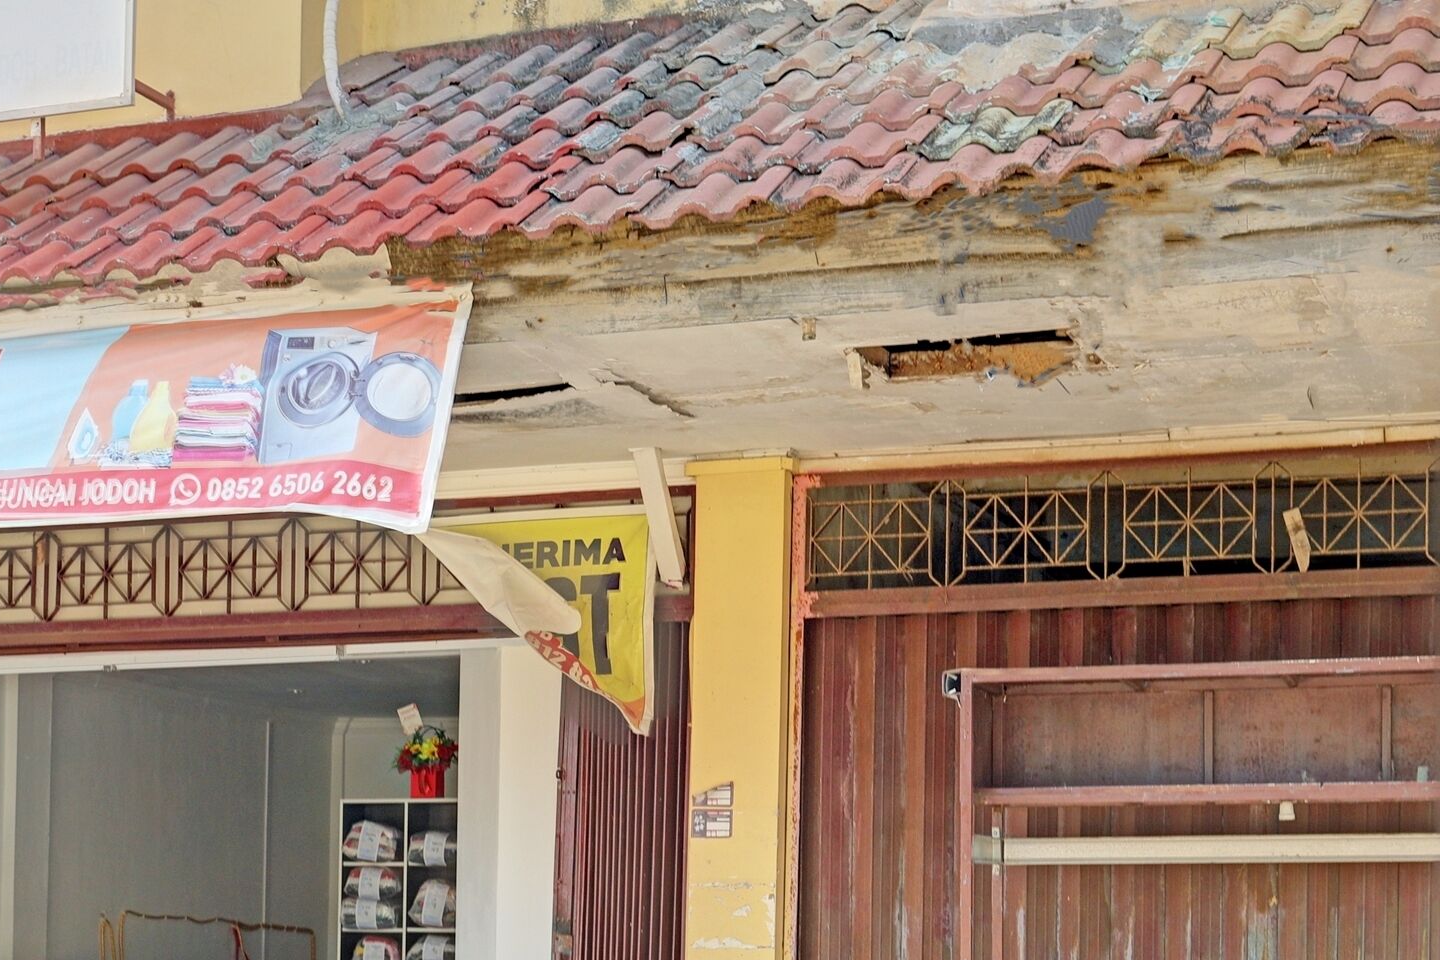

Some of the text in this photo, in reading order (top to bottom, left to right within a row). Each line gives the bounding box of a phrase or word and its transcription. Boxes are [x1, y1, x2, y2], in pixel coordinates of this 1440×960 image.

[78, 477, 158, 506] JODOH
[206, 470, 394, 503] 0852 6506 2662
